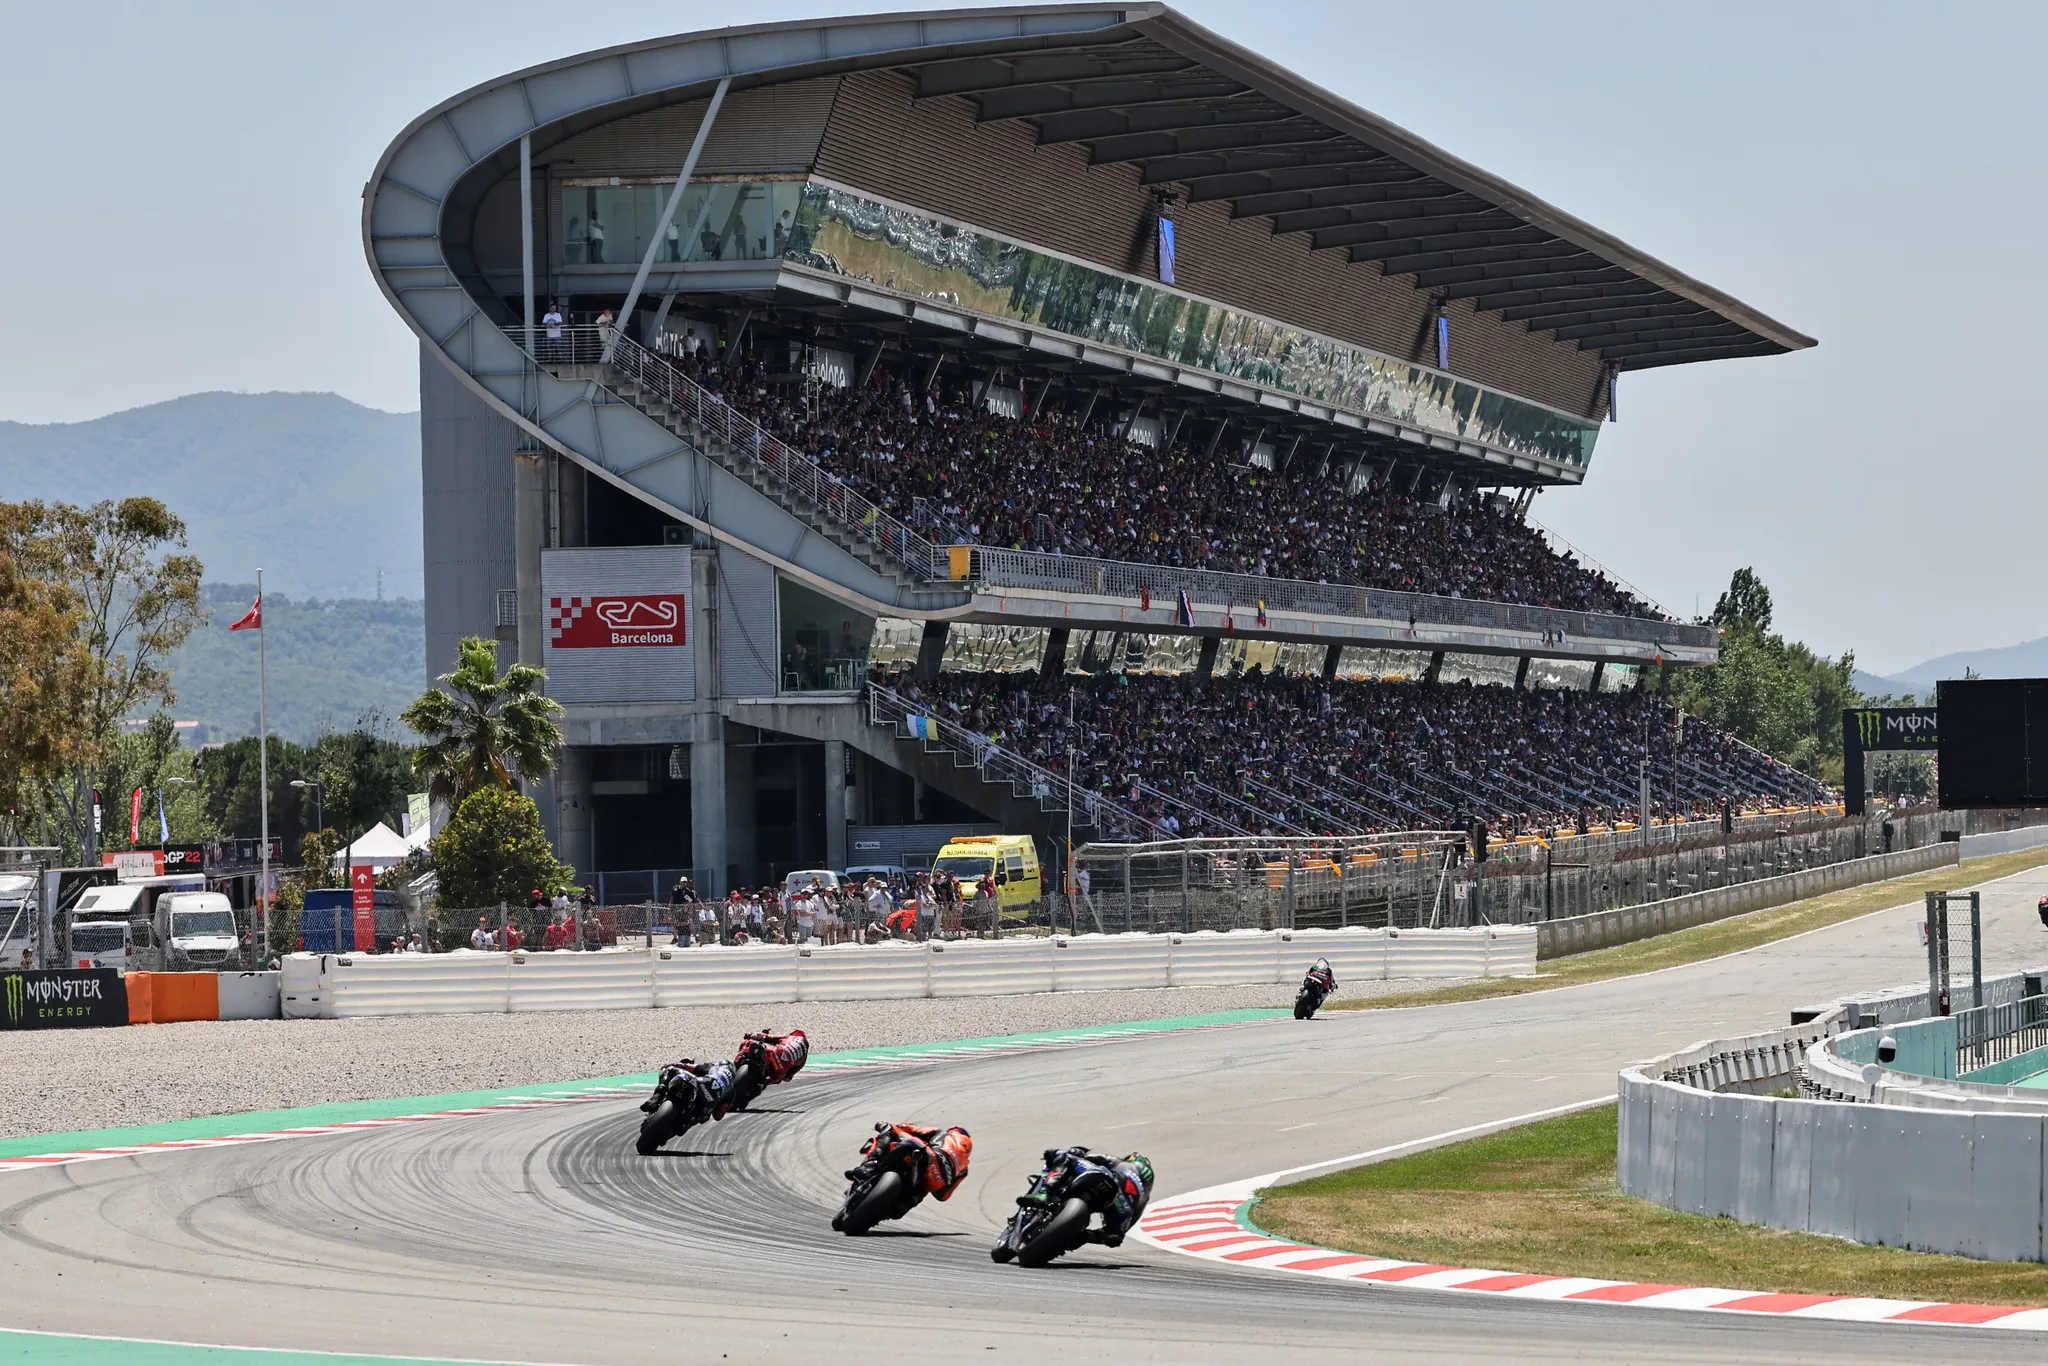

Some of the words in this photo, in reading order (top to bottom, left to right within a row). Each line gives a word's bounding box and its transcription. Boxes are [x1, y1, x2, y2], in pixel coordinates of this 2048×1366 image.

[611, 631, 673, 644] Barcelona
[1903, 735, 1939, 743] ENE
[26, 975, 103, 1004] MONSTER
[39, 1006, 92, 1018] ENERGY
